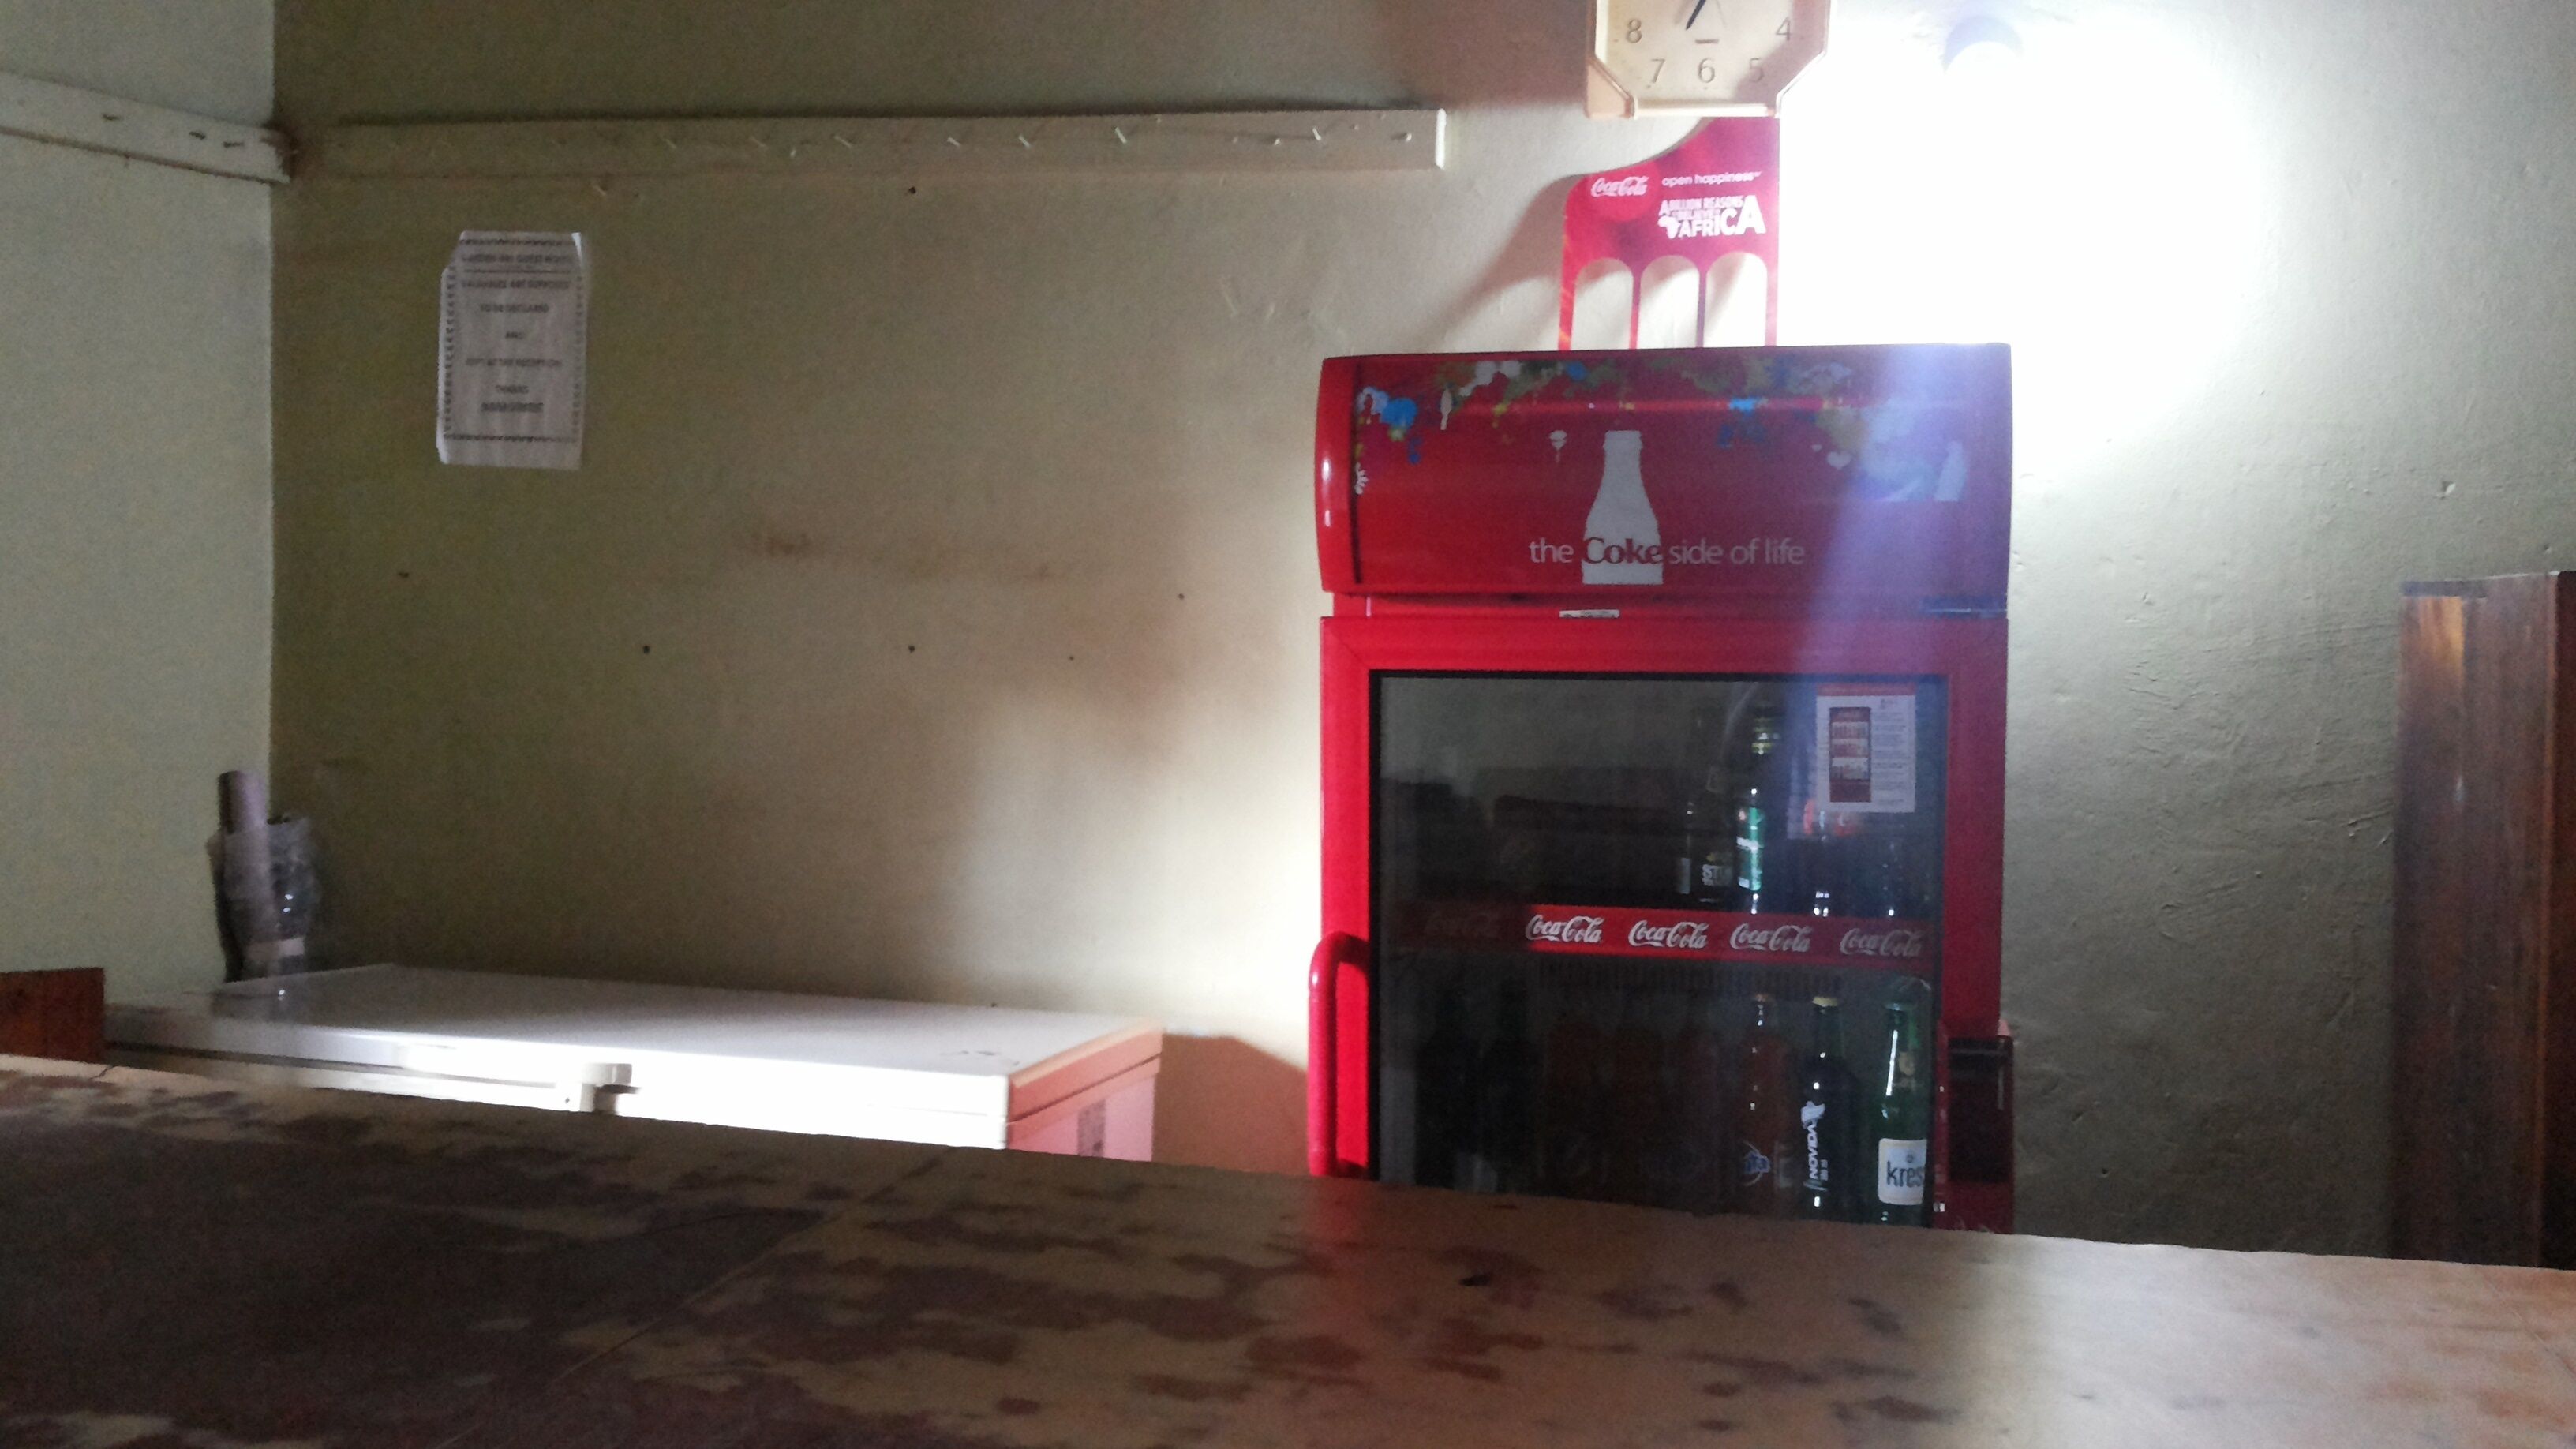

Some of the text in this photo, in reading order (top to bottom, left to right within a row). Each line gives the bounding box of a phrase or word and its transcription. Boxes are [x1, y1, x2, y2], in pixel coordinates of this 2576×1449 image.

[1626, 19, 1642, 43] 8
[1775, 17, 1792, 40] 4
[1650, 58, 1666, 83] 7
[1698, 58, 1716, 83] 6
[1748, 58, 1765, 83] 5
[1590, 175, 1649, 197] Coca-Cola
[1661, 171, 1755, 188] open happiness
[1678, 195, 1766, 238] AFRICA
[1529, 537, 1805, 565] the Coke side of life
[1525, 914, 1604, 942] Coca-Cola
[1628, 920, 1710, 949] Coca-Cola
[1729, 923, 1813, 953] Coca-Cola
[1840, 928, 1926, 957] Coca-Cola
[1806, 1123, 1818, 1180] NOVIDA
